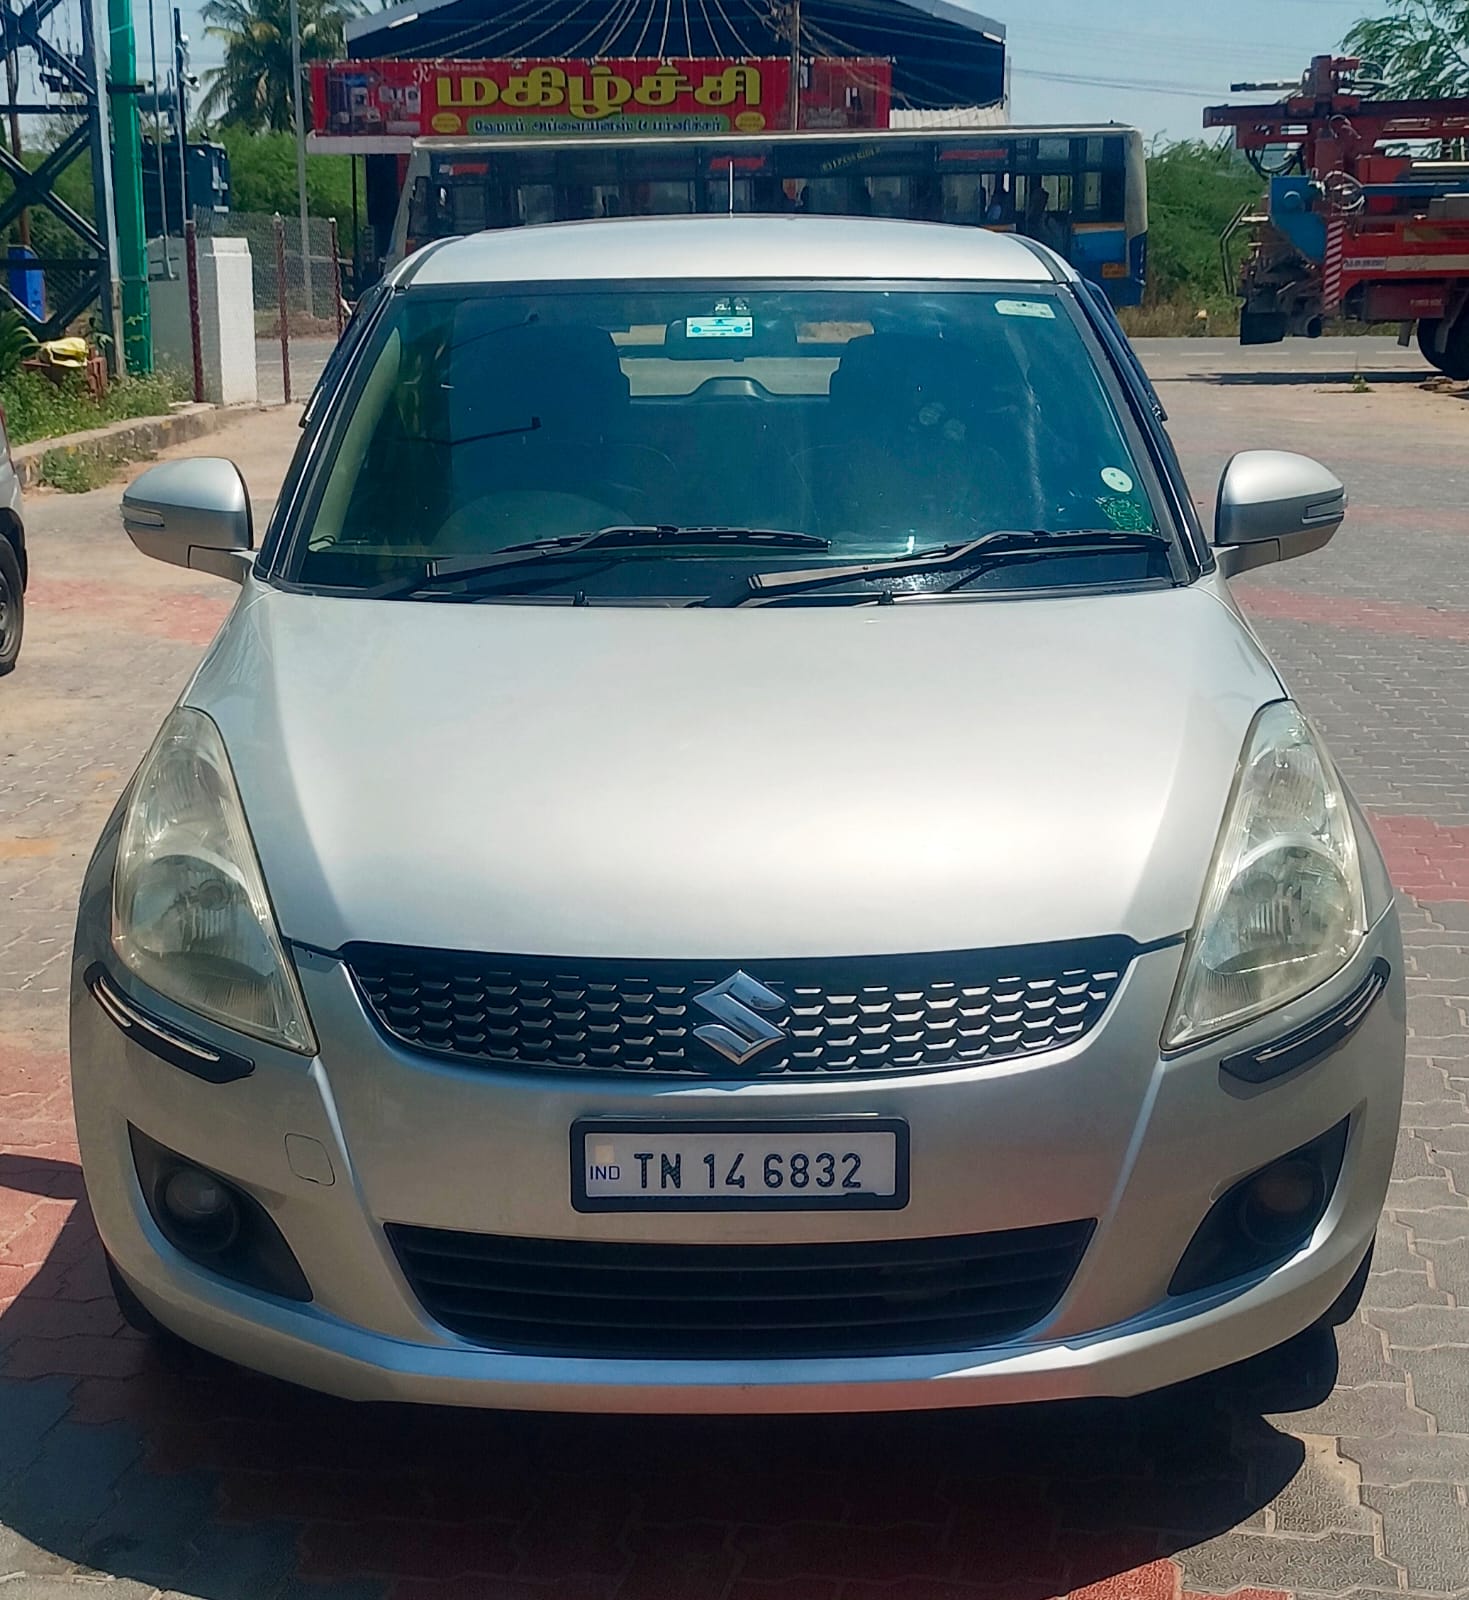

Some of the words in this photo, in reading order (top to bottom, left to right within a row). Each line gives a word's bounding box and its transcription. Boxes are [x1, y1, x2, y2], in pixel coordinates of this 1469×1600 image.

[436, 65, 761, 120] மகிழ்ச்சி
[589, 1165, 621, 1181] IND
[633, 1153, 682, 1189] TN
[703, 1153, 746, 1189] 14
[763, 1153, 862, 1189] 6832
